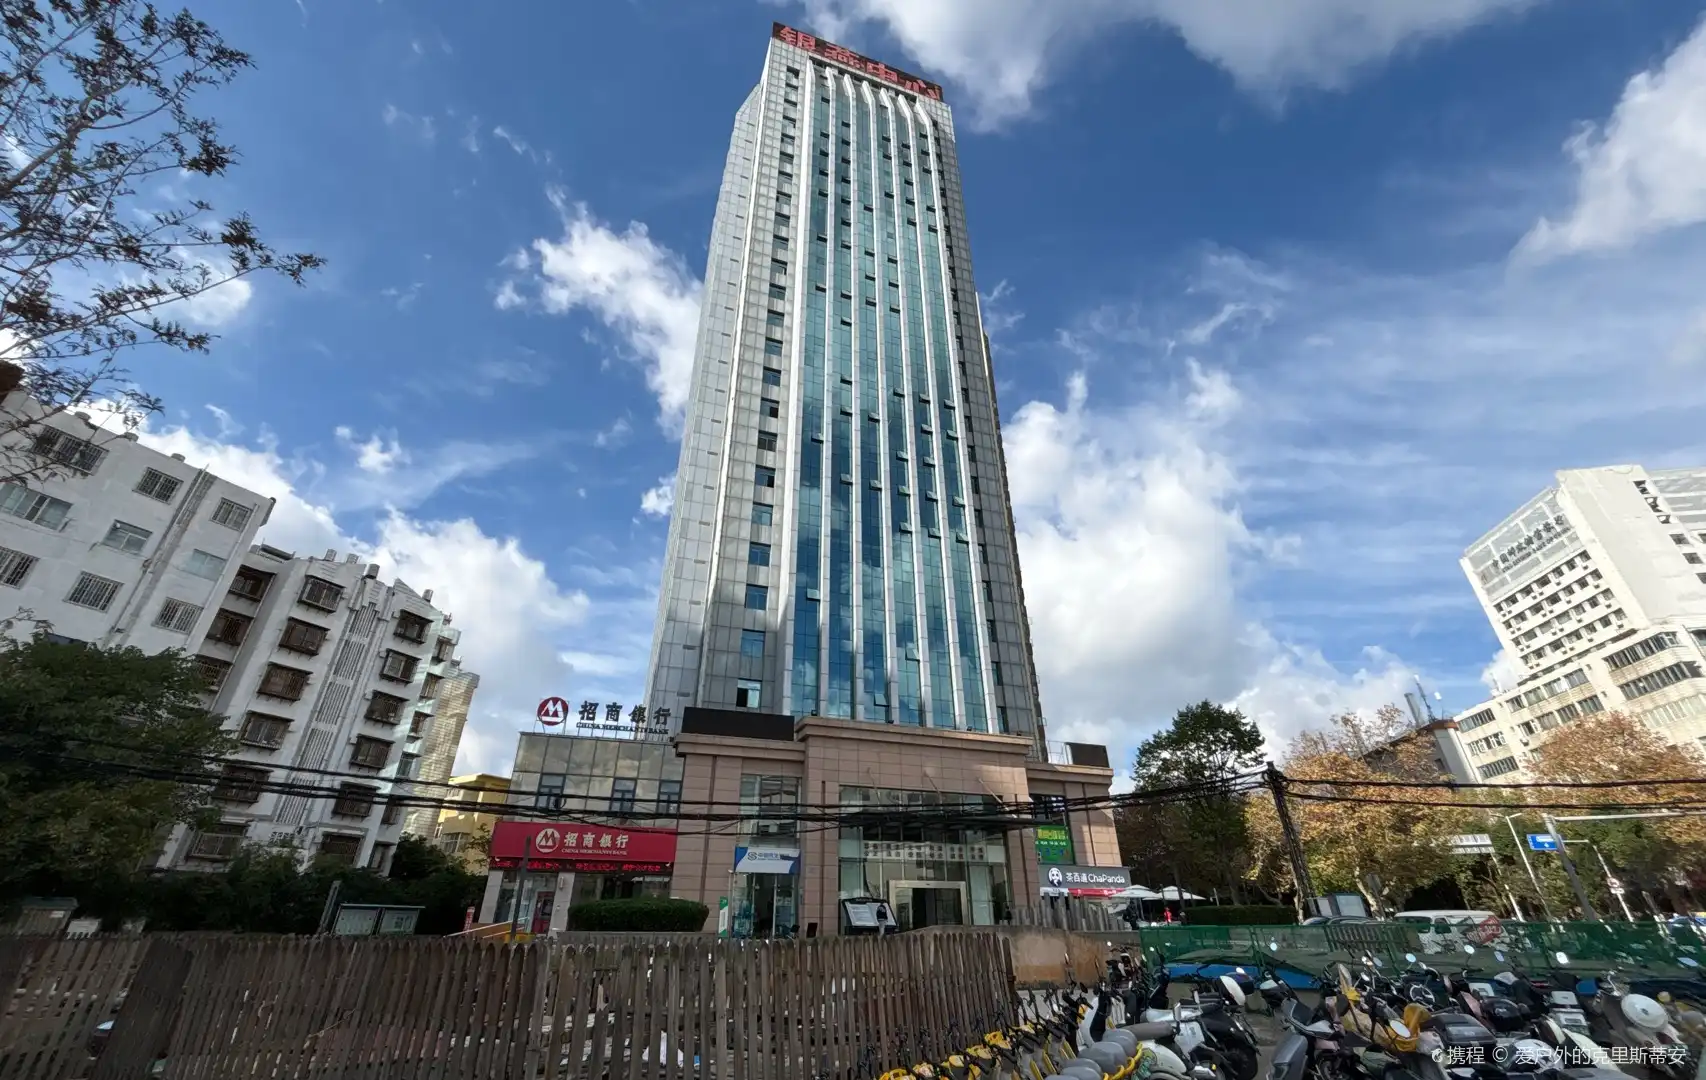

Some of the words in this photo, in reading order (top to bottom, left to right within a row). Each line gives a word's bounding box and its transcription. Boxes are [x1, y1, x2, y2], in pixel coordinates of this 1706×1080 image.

[578, 700, 671, 726] 招商银行
[576, 721, 601, 730] CHINA
[648, 727, 670, 735] BANK
[564, 831, 629, 848] 招商银行
[1088, 873, 1125, 884] ChaPanda
